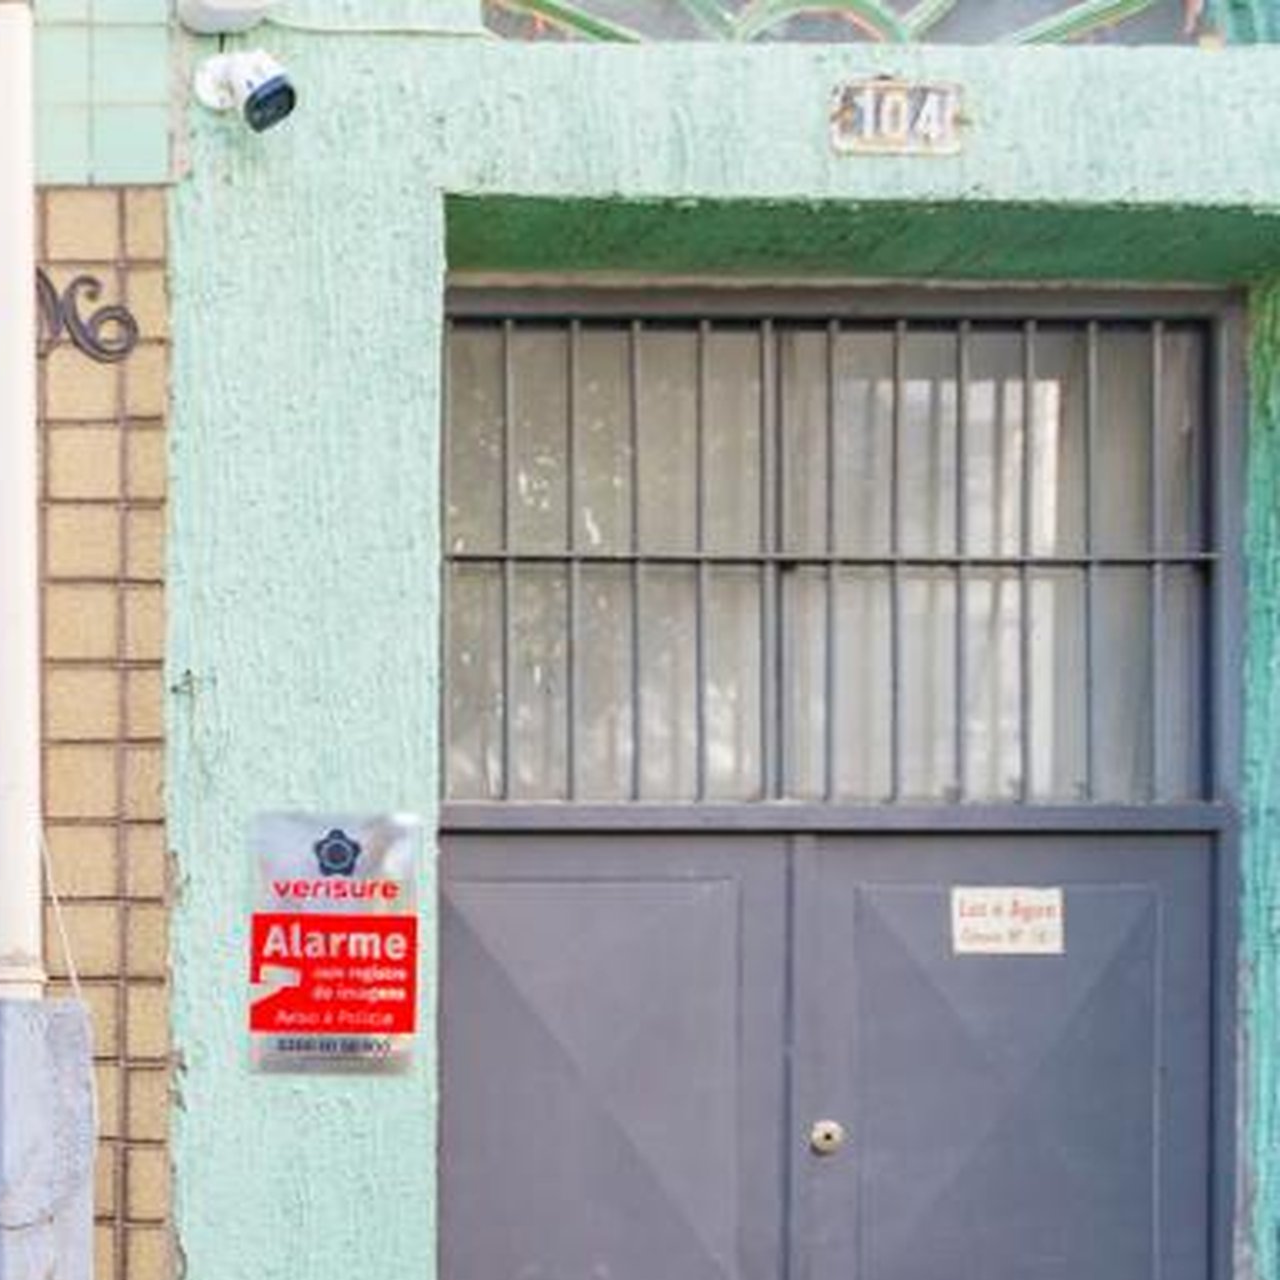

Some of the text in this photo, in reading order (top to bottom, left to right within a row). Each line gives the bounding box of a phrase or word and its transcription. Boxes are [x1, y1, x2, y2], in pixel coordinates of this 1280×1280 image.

[857, 87, 944, 144] 104
[272, 877, 401, 900] verisure
[262, 923, 409, 960] Alarme
[336, 983, 407, 1005] imagens
